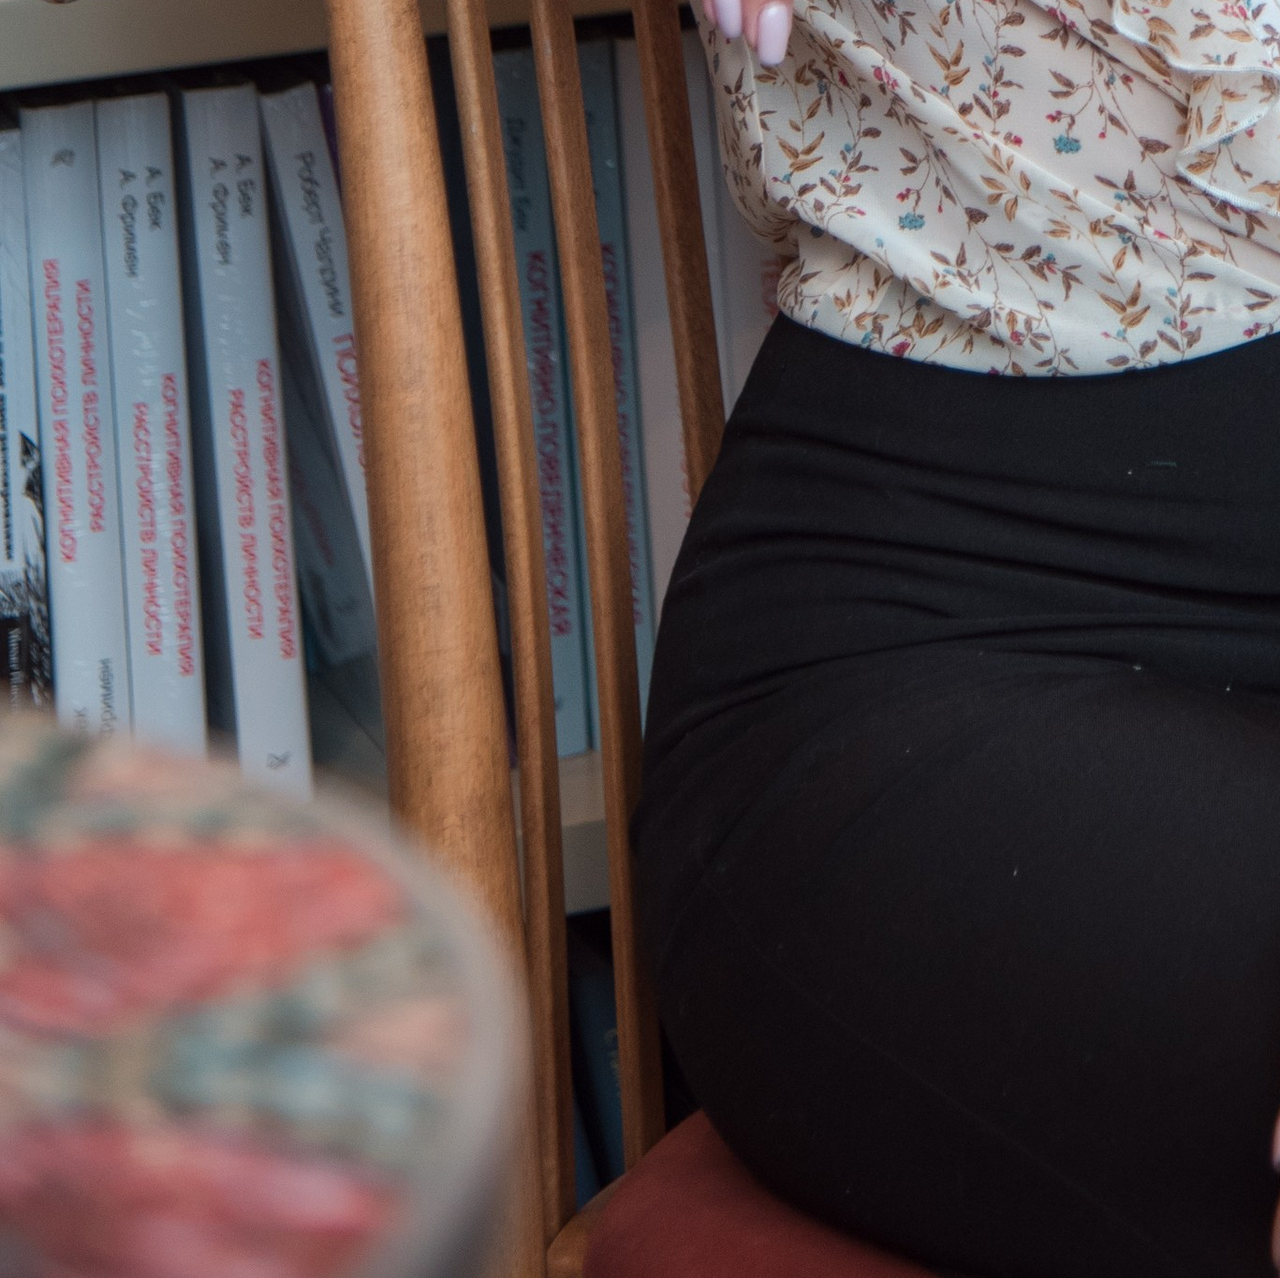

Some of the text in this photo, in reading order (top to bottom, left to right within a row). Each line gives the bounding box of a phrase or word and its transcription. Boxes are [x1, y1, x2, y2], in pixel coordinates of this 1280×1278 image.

[119, 194, 139, 278] Фримен
[298, 149, 325, 226] Роберт
[42, 258, 78, 564] КОГНИТИВНАЯ ПСИХОТЕРАПИЯ
[75, 278, 106, 534] РАССТРОЙСТВ ЛИЧНОСТИ
[132, 401, 163, 657] РАССТРОЙСТВ ЛИЧНОСТИ
[160, 372, 195, 678] КОГНИТИВНАЯ ПСИХОТЕРАПИЯ
[228, 387, 264, 641] РАССТРОЙСТВ ЛИЧНОСТИ
[256, 358, 297, 661] КОГНИТИВНАЯ ПСИХОТЕРАПИЯ
